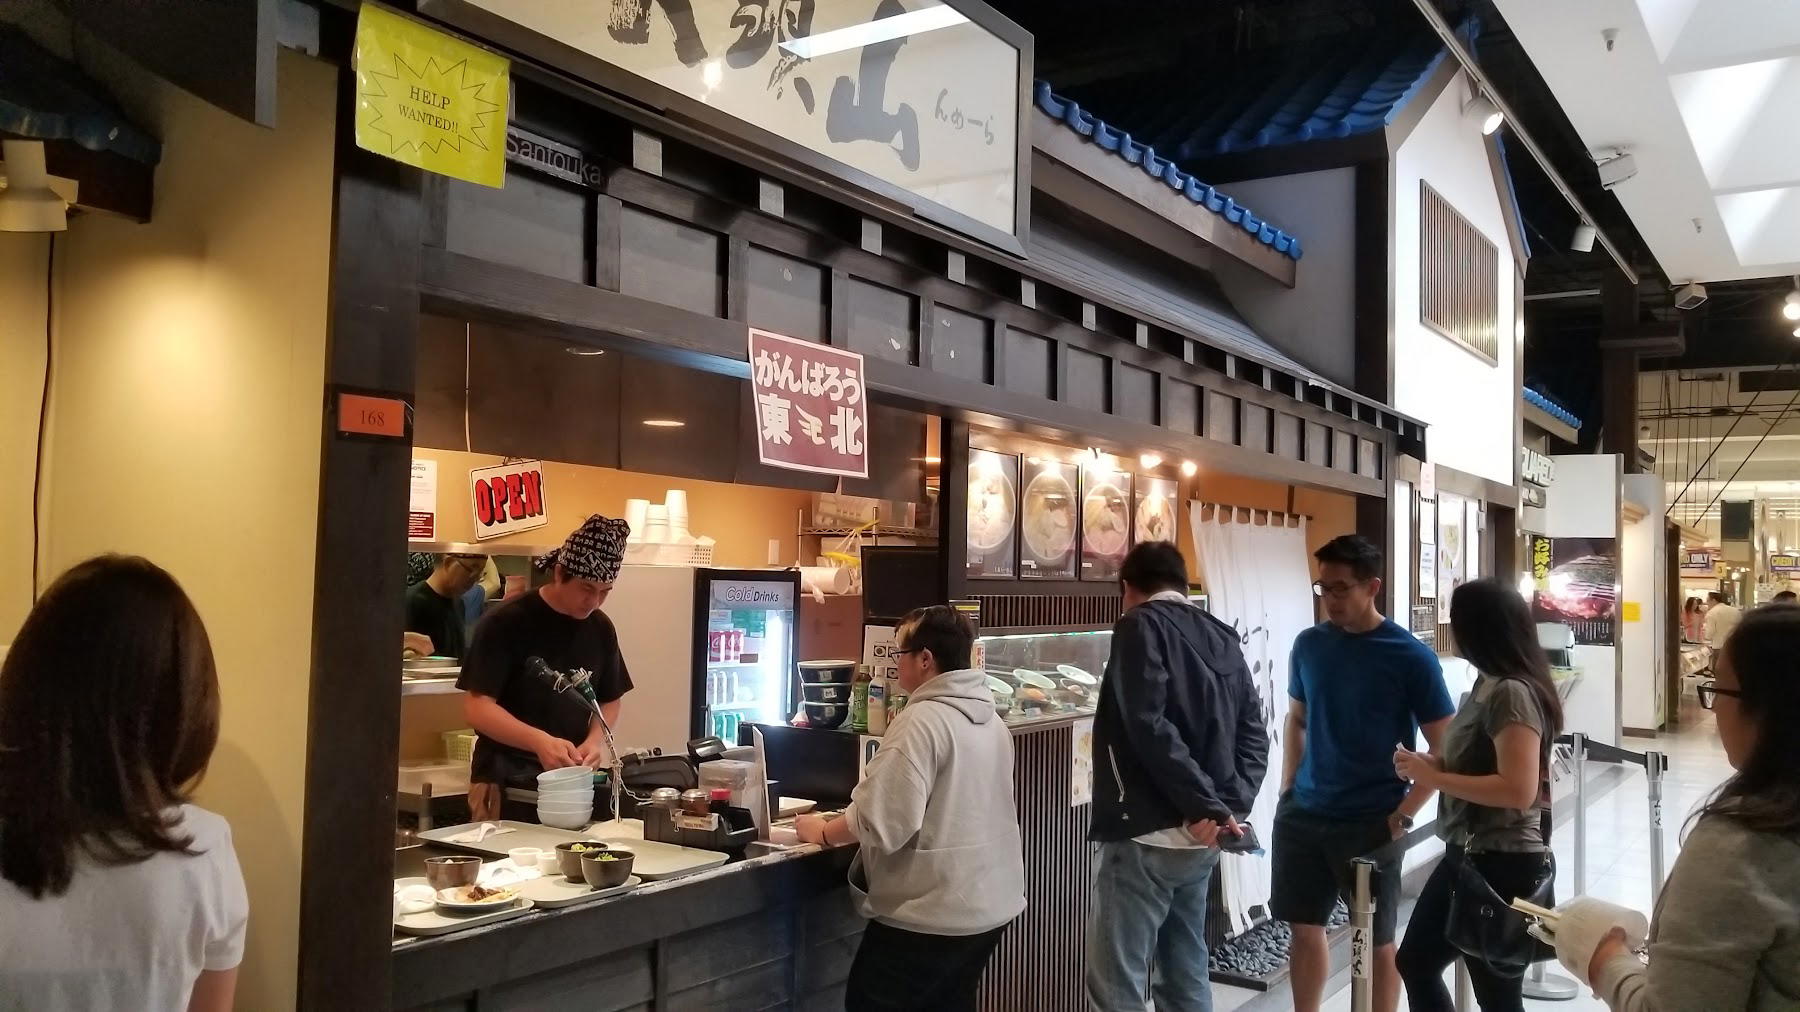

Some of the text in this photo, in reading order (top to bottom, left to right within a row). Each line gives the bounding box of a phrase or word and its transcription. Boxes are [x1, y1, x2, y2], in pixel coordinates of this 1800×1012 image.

[398, 104, 459, 134] WANTED!!
[410, 86, 451, 111] HELP
[506, 130, 602, 186] Santouka
[755, 349, 861, 405] がんばろう
[360, 409, 385, 428] 168
[475, 470, 545, 527] OPEN
[1534, 538, 1551, 590] お好み
[726, 586, 780, 603] Cold Drinks
